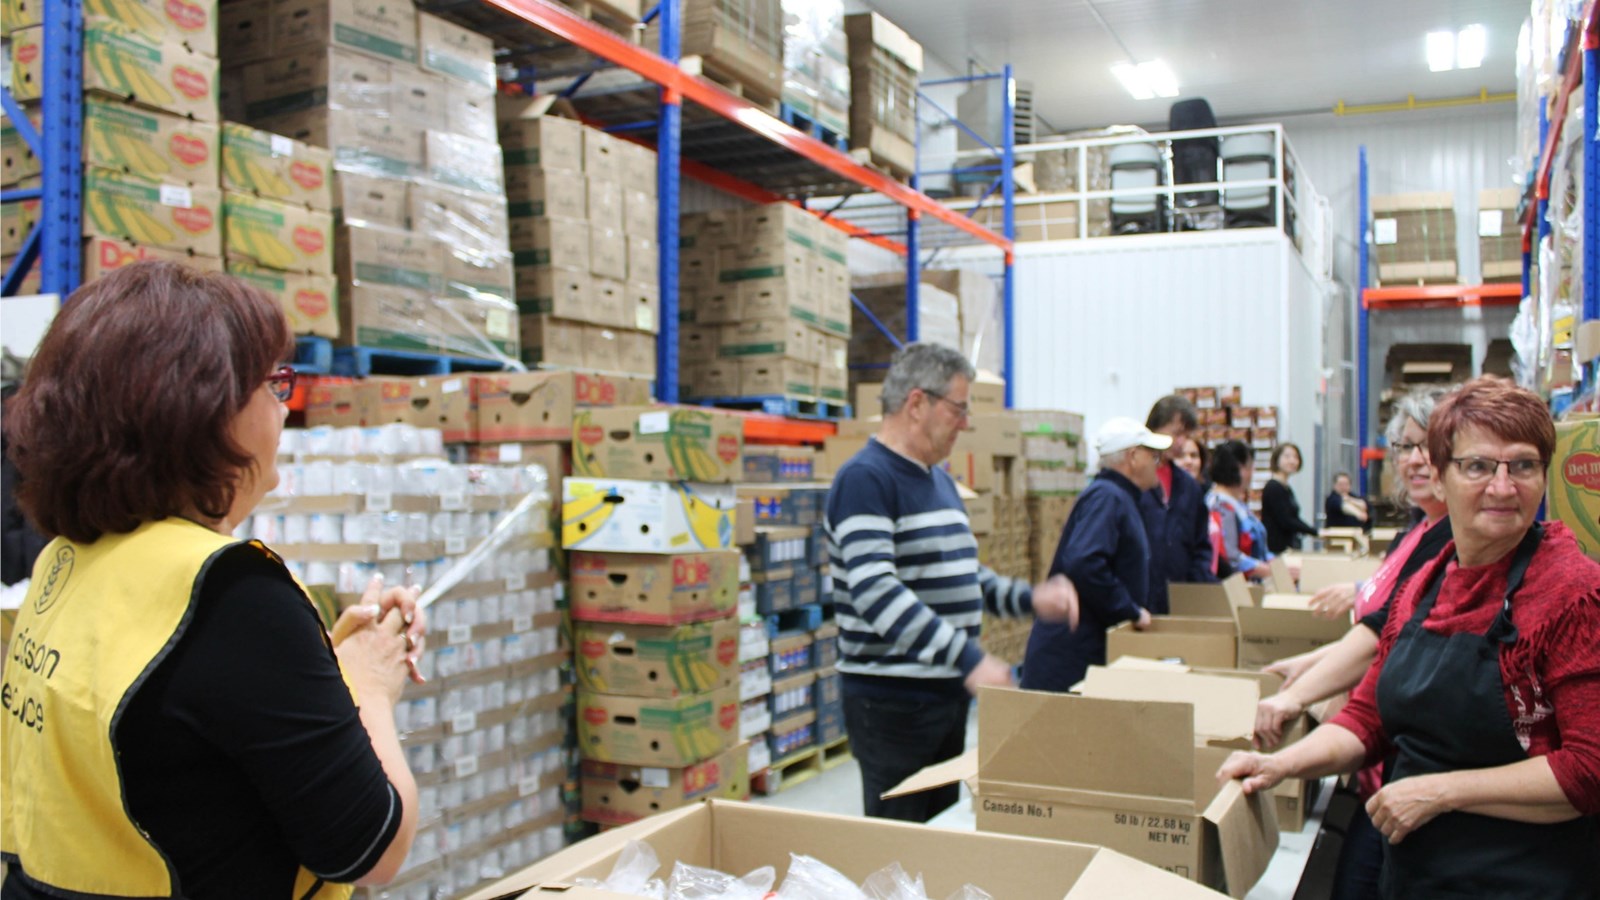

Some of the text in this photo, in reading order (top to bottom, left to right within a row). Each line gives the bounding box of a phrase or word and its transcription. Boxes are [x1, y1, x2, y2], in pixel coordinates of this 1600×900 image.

[575, 373, 616, 404] Dole
[1568, 462, 1588, 476] Del
[673, 556, 709, 586] Dole
[983, 799, 1024, 815] Canada
[1114, 813, 1127, 825] 50
[1129, 815, 1139, 826] lb
[1147, 816, 1176, 830] 22.68
[1178, 819, 1191, 833] kg
[1148, 831, 1190, 846] NET WT.
